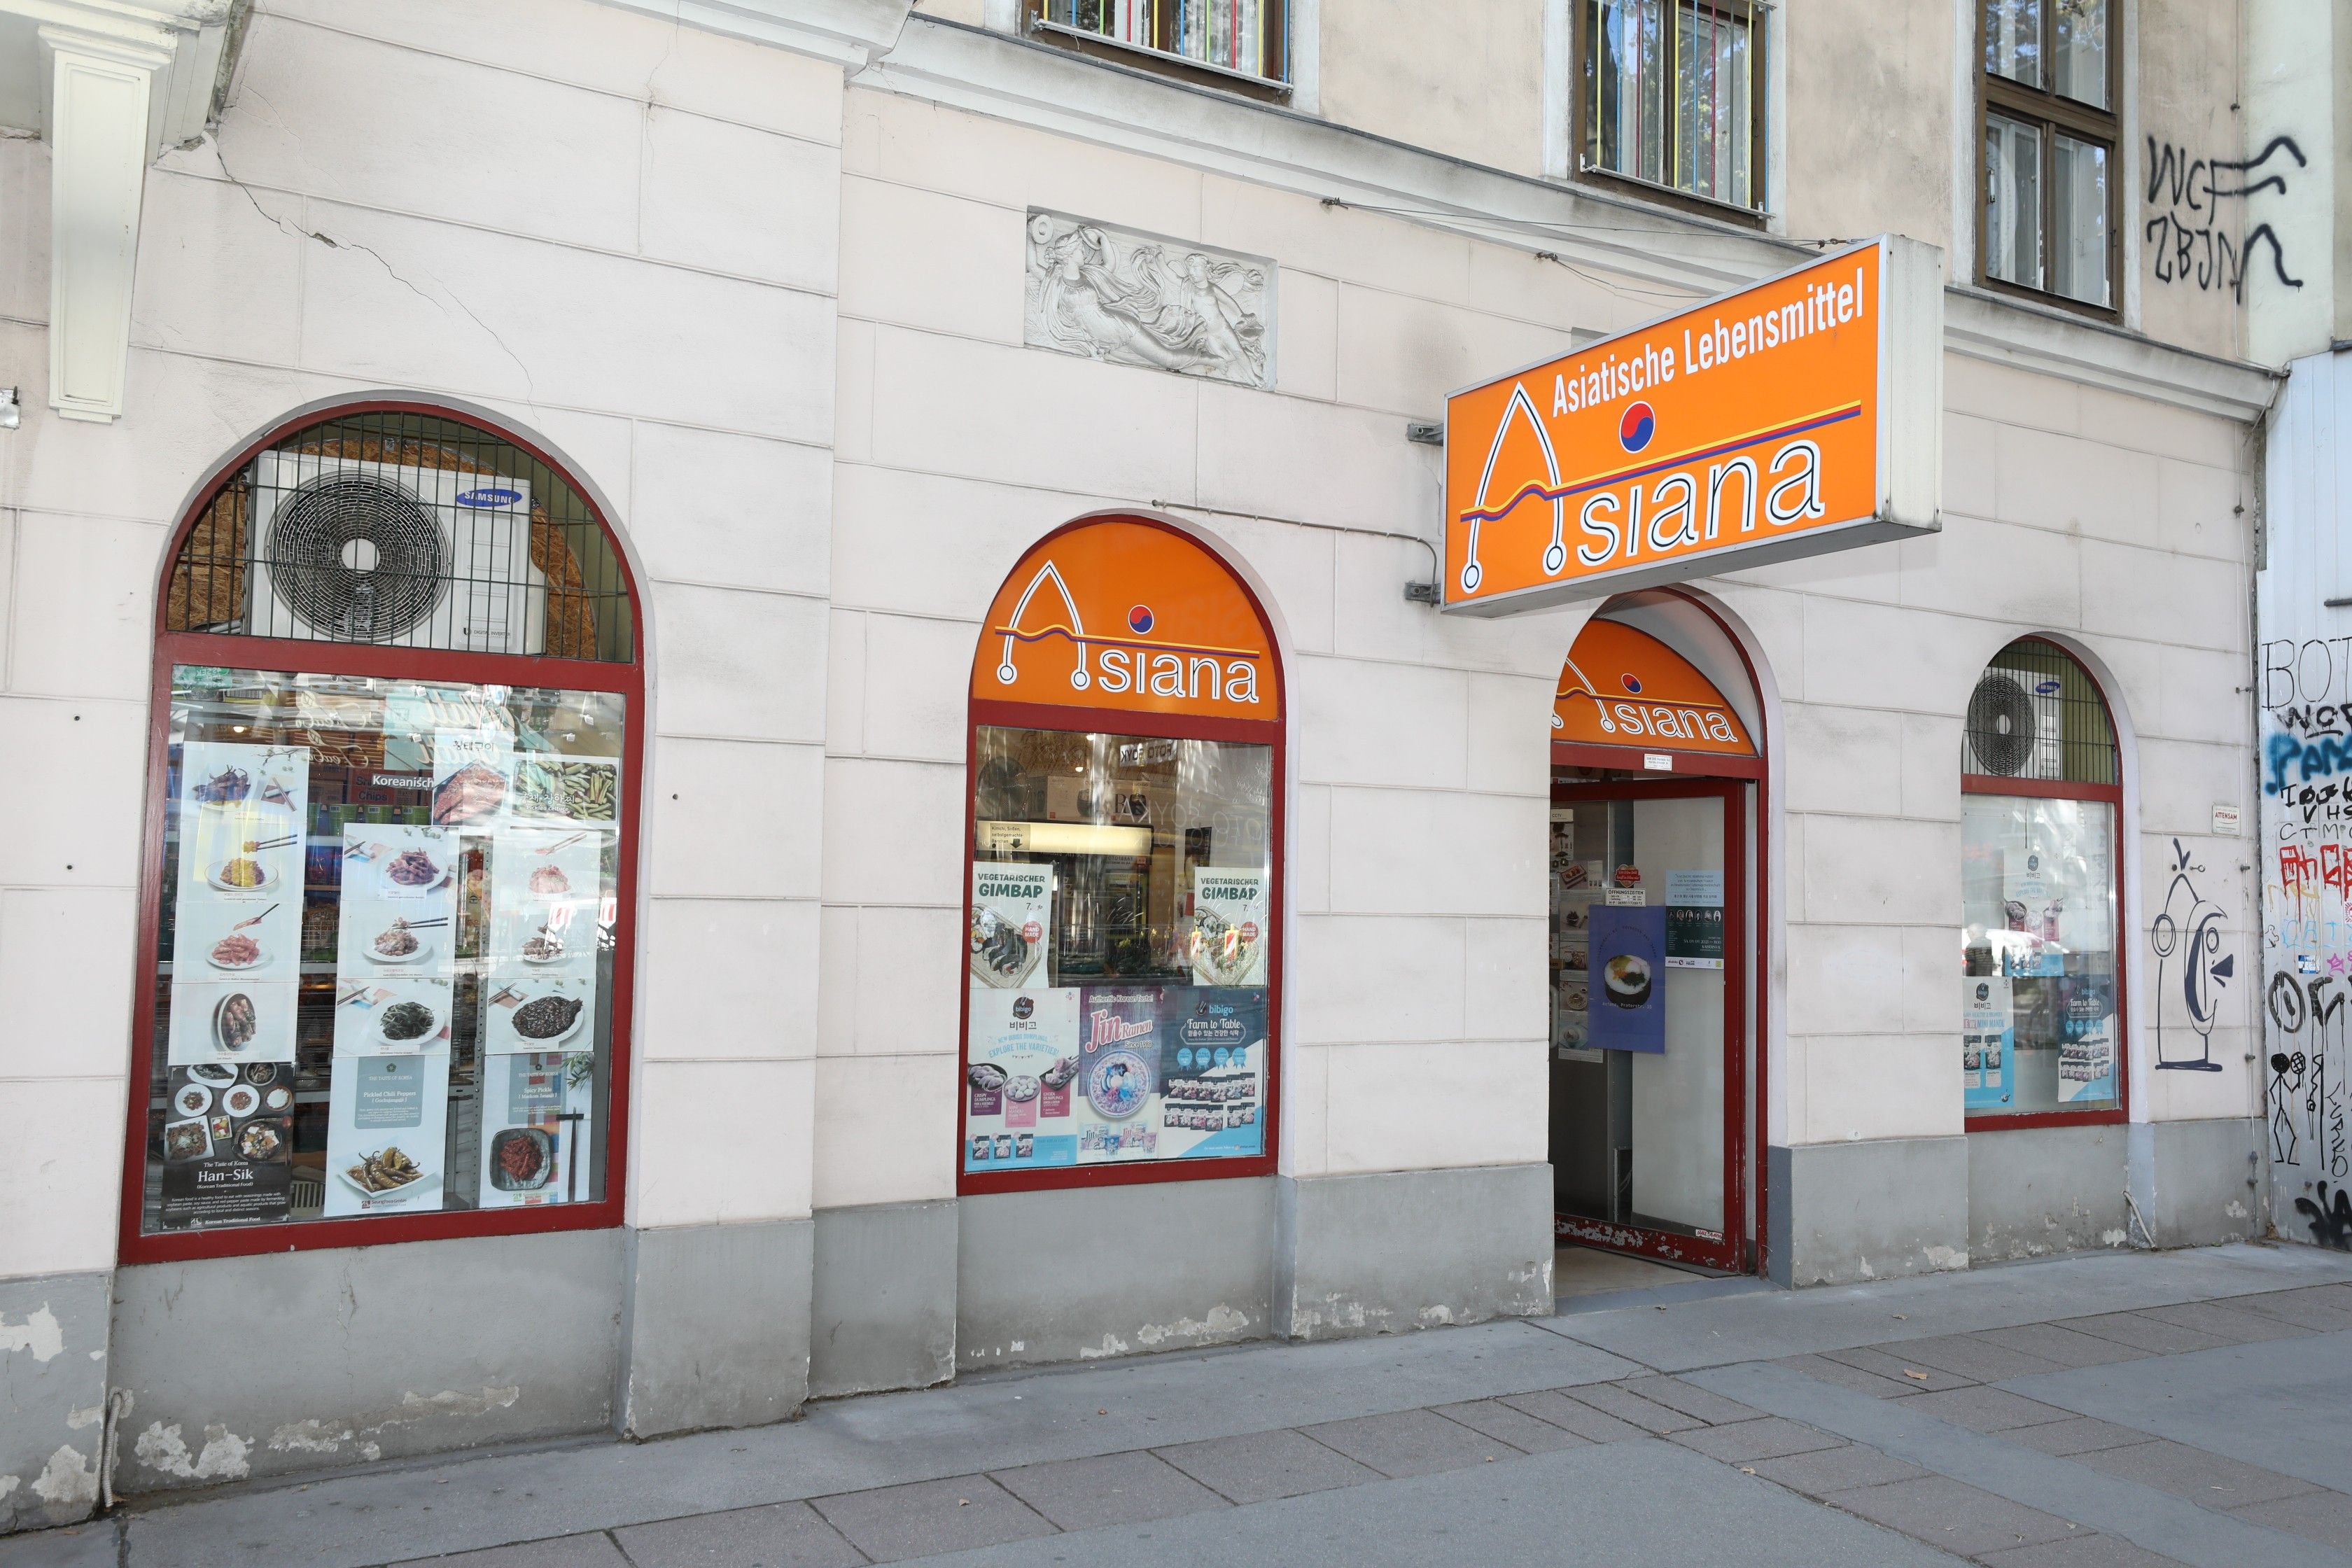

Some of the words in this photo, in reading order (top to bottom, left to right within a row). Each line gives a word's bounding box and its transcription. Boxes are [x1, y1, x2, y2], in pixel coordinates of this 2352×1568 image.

[1552, 344, 1675, 419] Asiatische
[1684, 267, 1863, 376] Lebensmittel
[1461, 380, 1825, 594] Asiana
[464, 491, 514, 504] SAMSUNG
[996, 559, 1259, 704] Asiana
[372, 775, 434, 788] Koreanisch
[373, 791, 402, 802] Chips
[2215, 811, 2237, 820] ATTENSAM
[978, 873, 1046, 883] VEGETARISCHER
[1200, 877, 1259, 886] VEGETARISCHER
[979, 883, 1043, 898] GIMBAP
[1202, 887, 1258, 900] GIMBAP
[1089, 994, 1116, 1003] Authentic
[1116, 994, 1138, 1002] Korean
[1138, 993, 1154, 1002] Taste!
[2081, 988, 2096, 997] bibigo
[1974, 1002, 1991, 1010] 비비고
[2070, 998, 2082, 1007] Farm
[2087, 998, 2100, 1007] Table
[1209, 1004, 1233, 1016] bibigo
[1009, 1021, 1037, 1031] 비비고
[1121, 1020, 1154, 1040] Ramen
[1186, 1018, 1208, 1030] Farm
[1210, 1020, 1218, 1029] to
[1219, 1018, 1240, 1029] Table
[1086, 1009, 1121, 1054] Jin
[988, 1044, 1015, 1058] EXPLORE
[1029, 1042, 1060, 1057] VARIETIES!
[198, 1168, 253, 1182] Han-Sik
